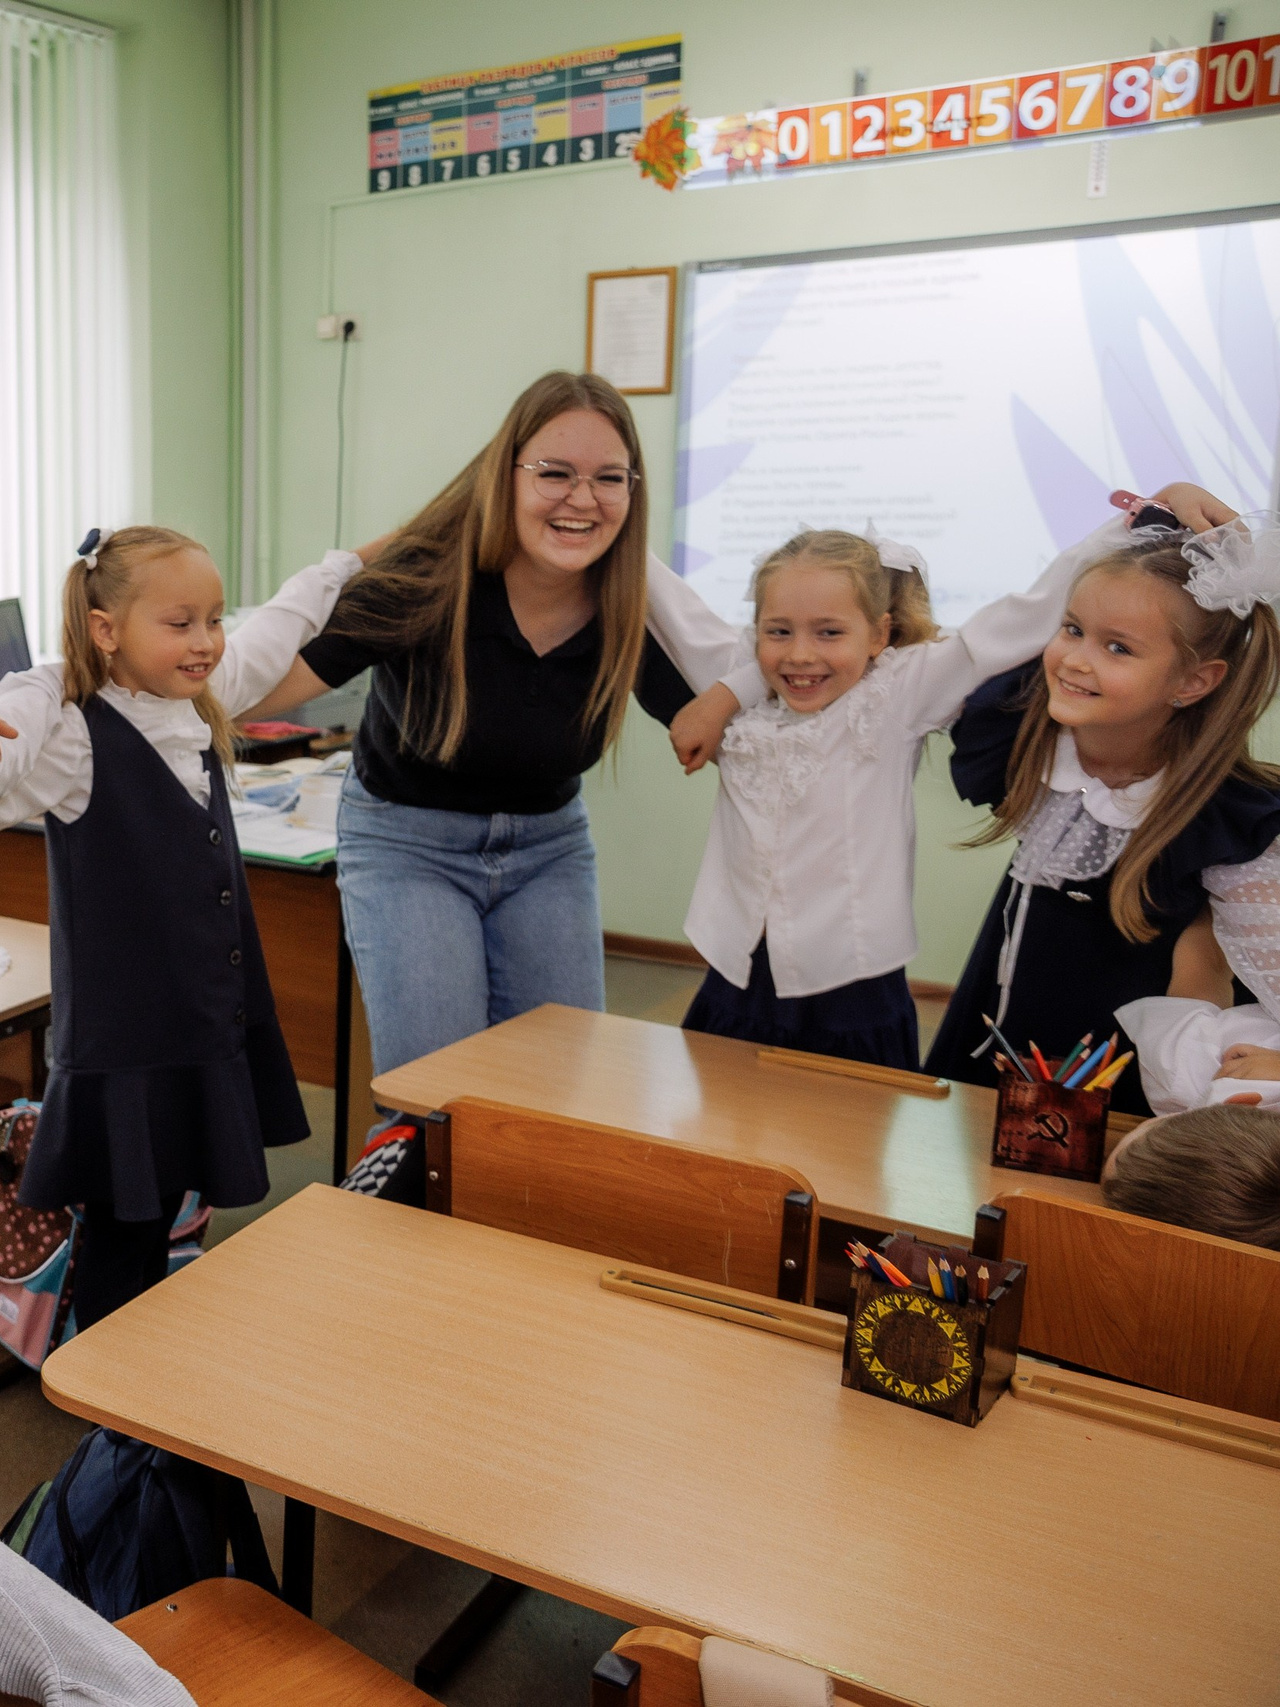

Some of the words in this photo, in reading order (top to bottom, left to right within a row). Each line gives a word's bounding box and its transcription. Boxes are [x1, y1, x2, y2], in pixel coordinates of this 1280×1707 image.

[778, 116, 808, 161] 0
[820, 110, 842, 156] 1
[852, 104, 885, 153] 2
[892, 99, 926, 148] 3
[932, 93, 967, 141] 4
[975, 86, 1011, 137] 5
[1019, 79, 1057, 131] 6
[1066, 73, 1104, 126] 7
[1109, 66, 1150, 118] 8
[1162, 58, 1200, 112] 9
[1208, 48, 1256, 105] 10
[377, 169, 391, 191] 9
[408, 165, 422, 187] 8
[441, 159, 455, 181] 7
[476, 154, 491, 177] 6
[507, 149, 521, 172] 5
[542, 144, 558, 166] 4
[579, 137, 595, 161] 3
